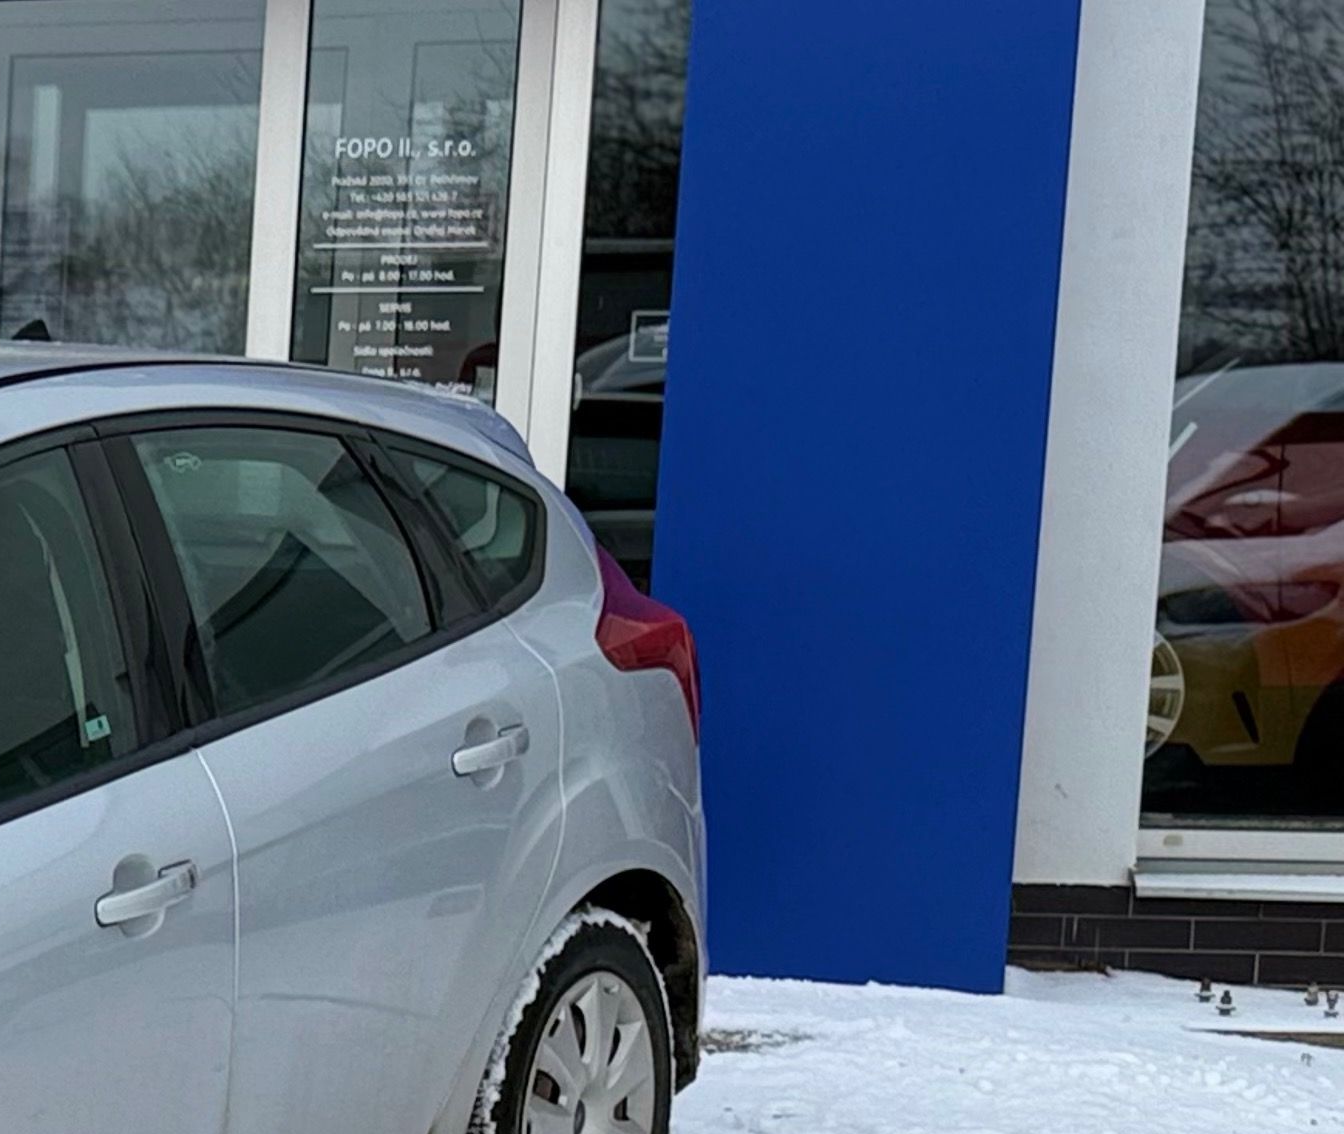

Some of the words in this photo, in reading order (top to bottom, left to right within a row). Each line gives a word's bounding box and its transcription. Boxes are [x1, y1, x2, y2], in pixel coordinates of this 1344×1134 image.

[334, 137, 393, 159] FOPO
[427, 139, 477, 157] s.r.o.
[378, 302, 412, 314] SERVIS
